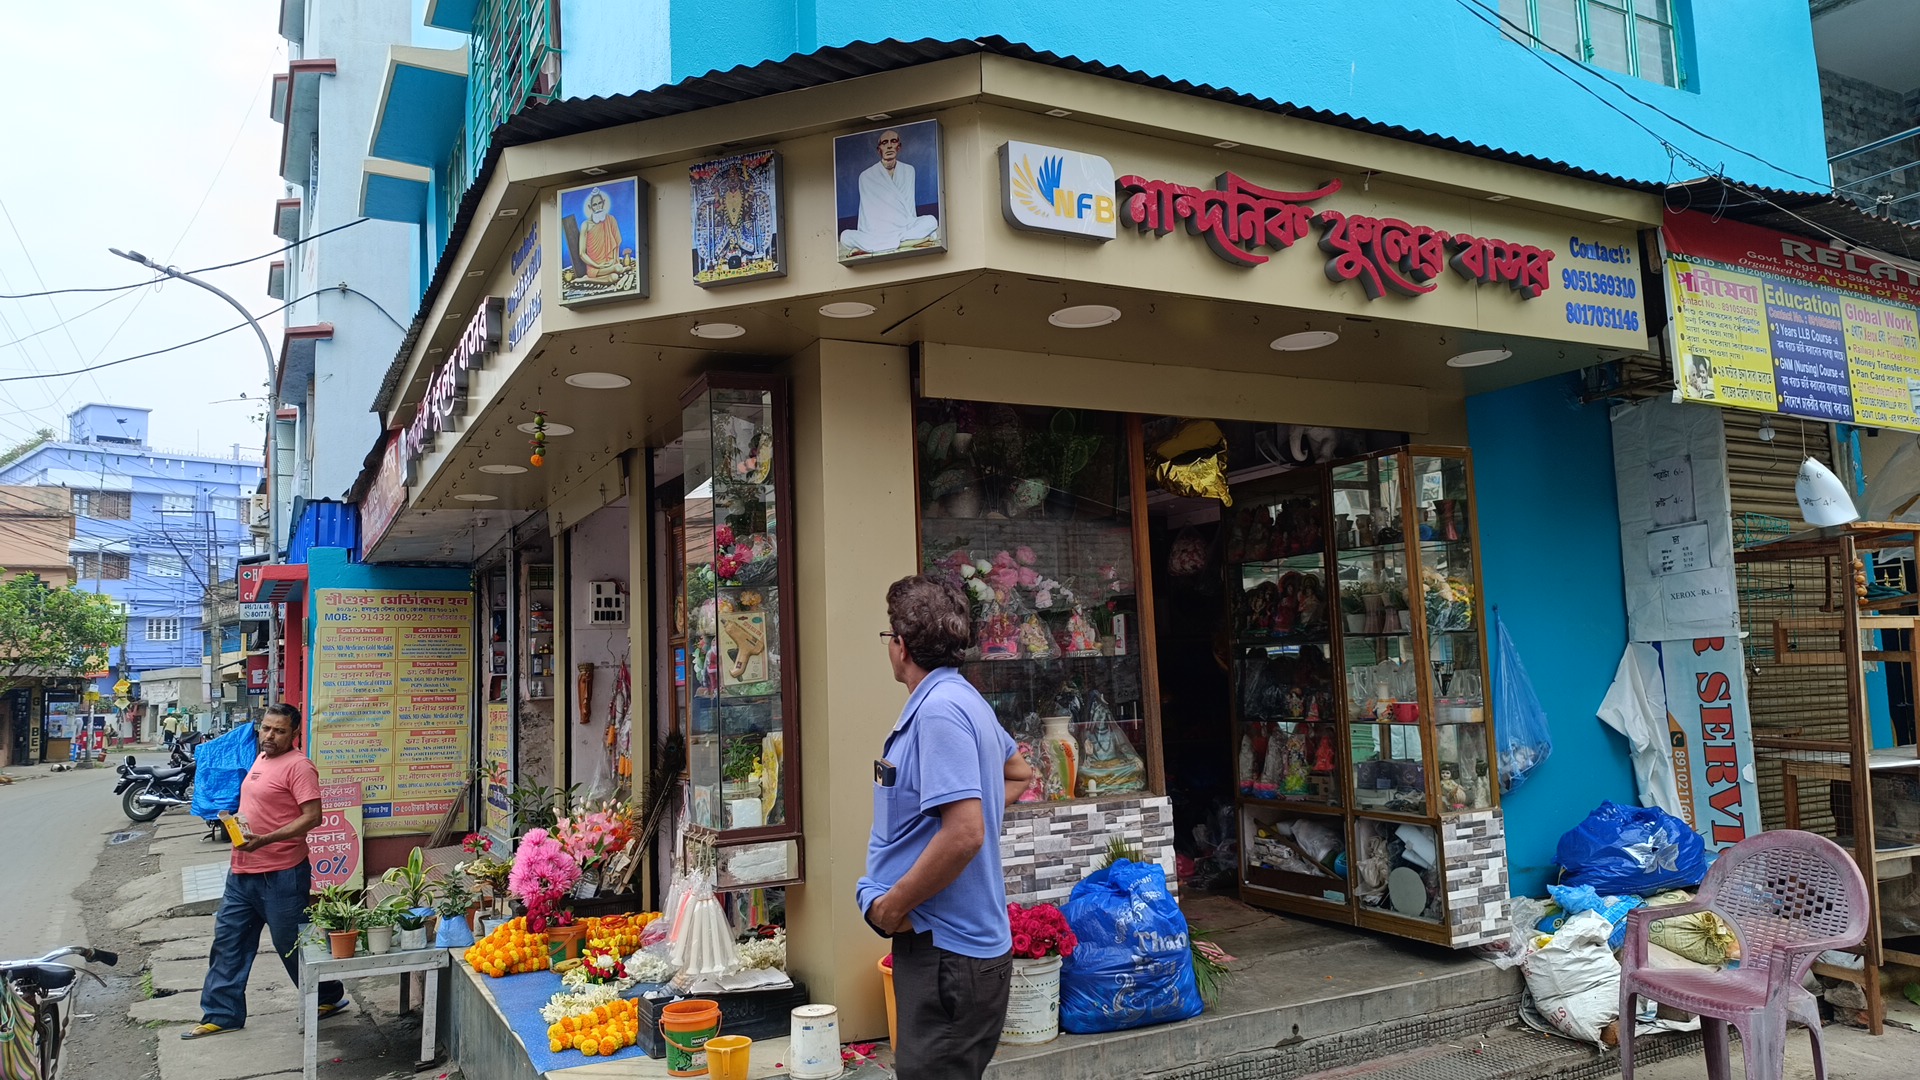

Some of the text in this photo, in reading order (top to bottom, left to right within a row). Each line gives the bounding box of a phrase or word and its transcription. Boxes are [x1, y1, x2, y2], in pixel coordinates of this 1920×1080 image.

[1054, 188, 1114, 223] NFB
[1569, 236, 1631, 264] Contact:
[1672, 252, 1700, 265] NGO
[1703, 259, 1715, 267] ID
[1746, 250, 1781, 265] Govt.
[1785, 259, 1821, 273] Regd.
[1562, 268, 1636, 299] 9051369310
[1676, 268, 1759, 305] পরিষেবা
[1738, 257, 1793, 275] Organised
[1795, 268, 1808, 280] by
[1835, 278, 1871, 293] Unit
[1763, 283, 1841, 318] Education
[1566, 302, 1639, 331] 8017031146
[1844, 302, 1882, 326] Global
[1884, 310, 1914, 332] Work
[1774, 322, 1780, 335] 3
[1780, 323, 1798, 338] Years
[1798, 326, 1811, 340] LLB
[1811, 329, 1832, 345] Course
[1819, 363, 1839, 378] Course
[1854, 356, 1903, 373] Money Transfer
[1855, 368, 1869, 379] Pan
[1869, 371, 1886, 382] Card
[447, 597, 469, 606] হল
[1670, 590, 1696, 601] XEROX
[324, 613, 424, 622] MOB:- 91432 00922
[1695, 671, 1747, 854] SERVI
[1674, 750, 1692, 828] 891021160
[305, 831, 346, 845] টাকার
